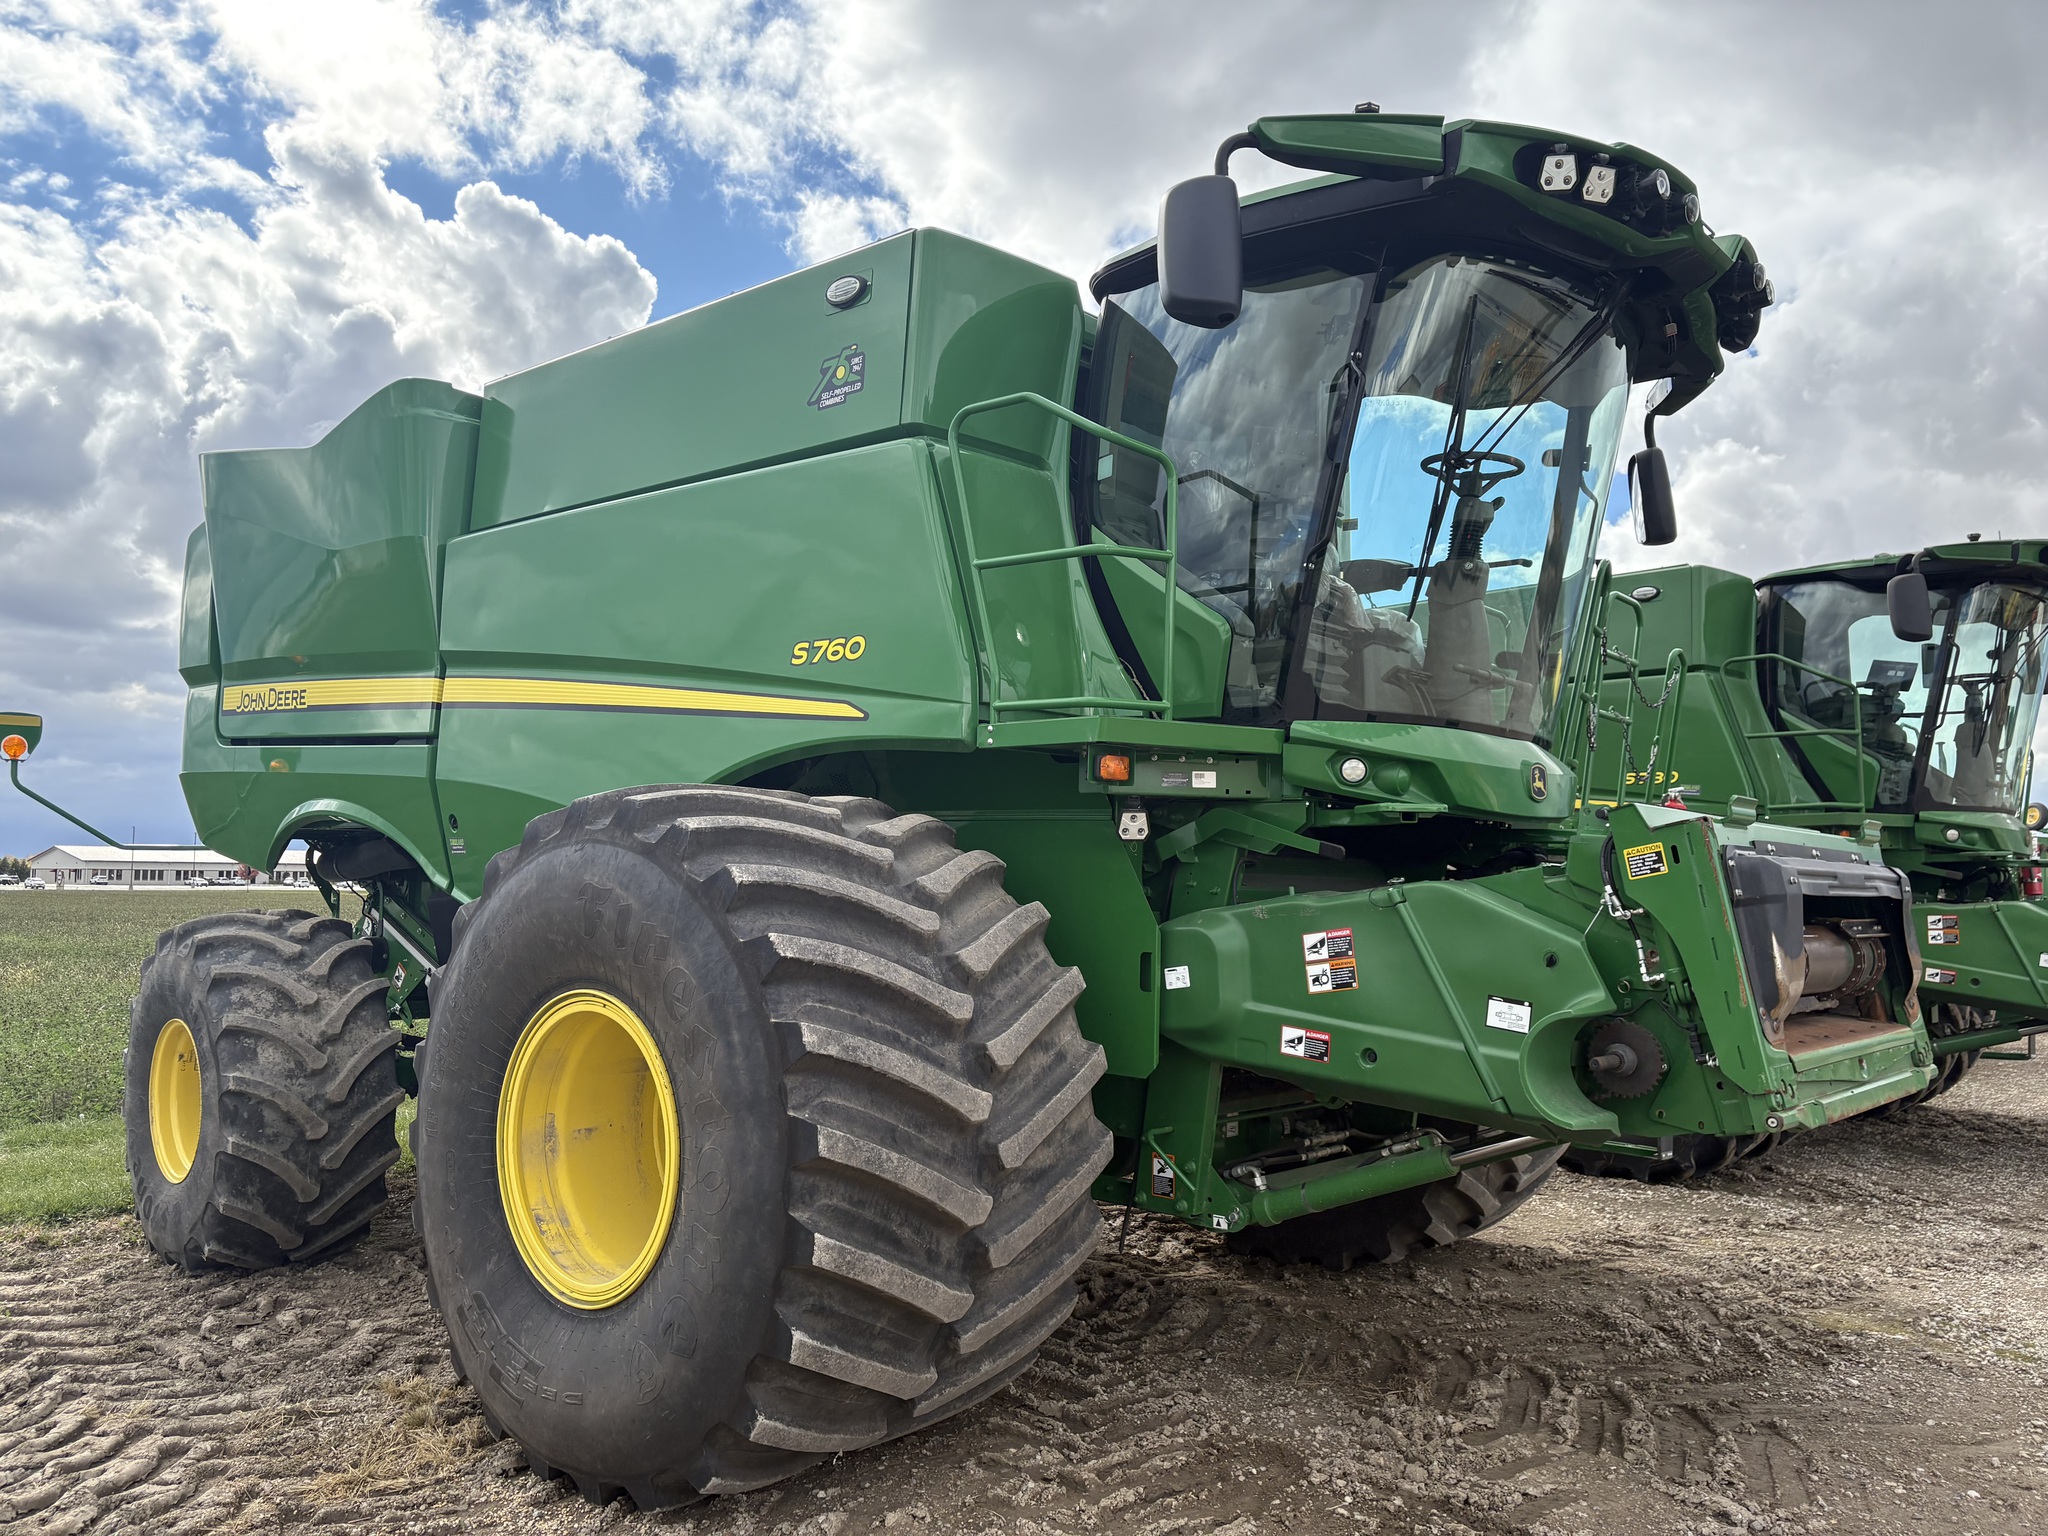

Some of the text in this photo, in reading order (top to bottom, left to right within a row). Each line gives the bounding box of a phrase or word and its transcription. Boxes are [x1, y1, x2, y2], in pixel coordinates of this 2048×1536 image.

[821, 382, 861, 400] SELF-PROPELLED
[819, 394, 845, 408] COMBINES
[790, 635, 866, 666] S760
[236, 687, 307, 711] JOHN DEERE
[1631, 844, 1661, 855] CAUTION
